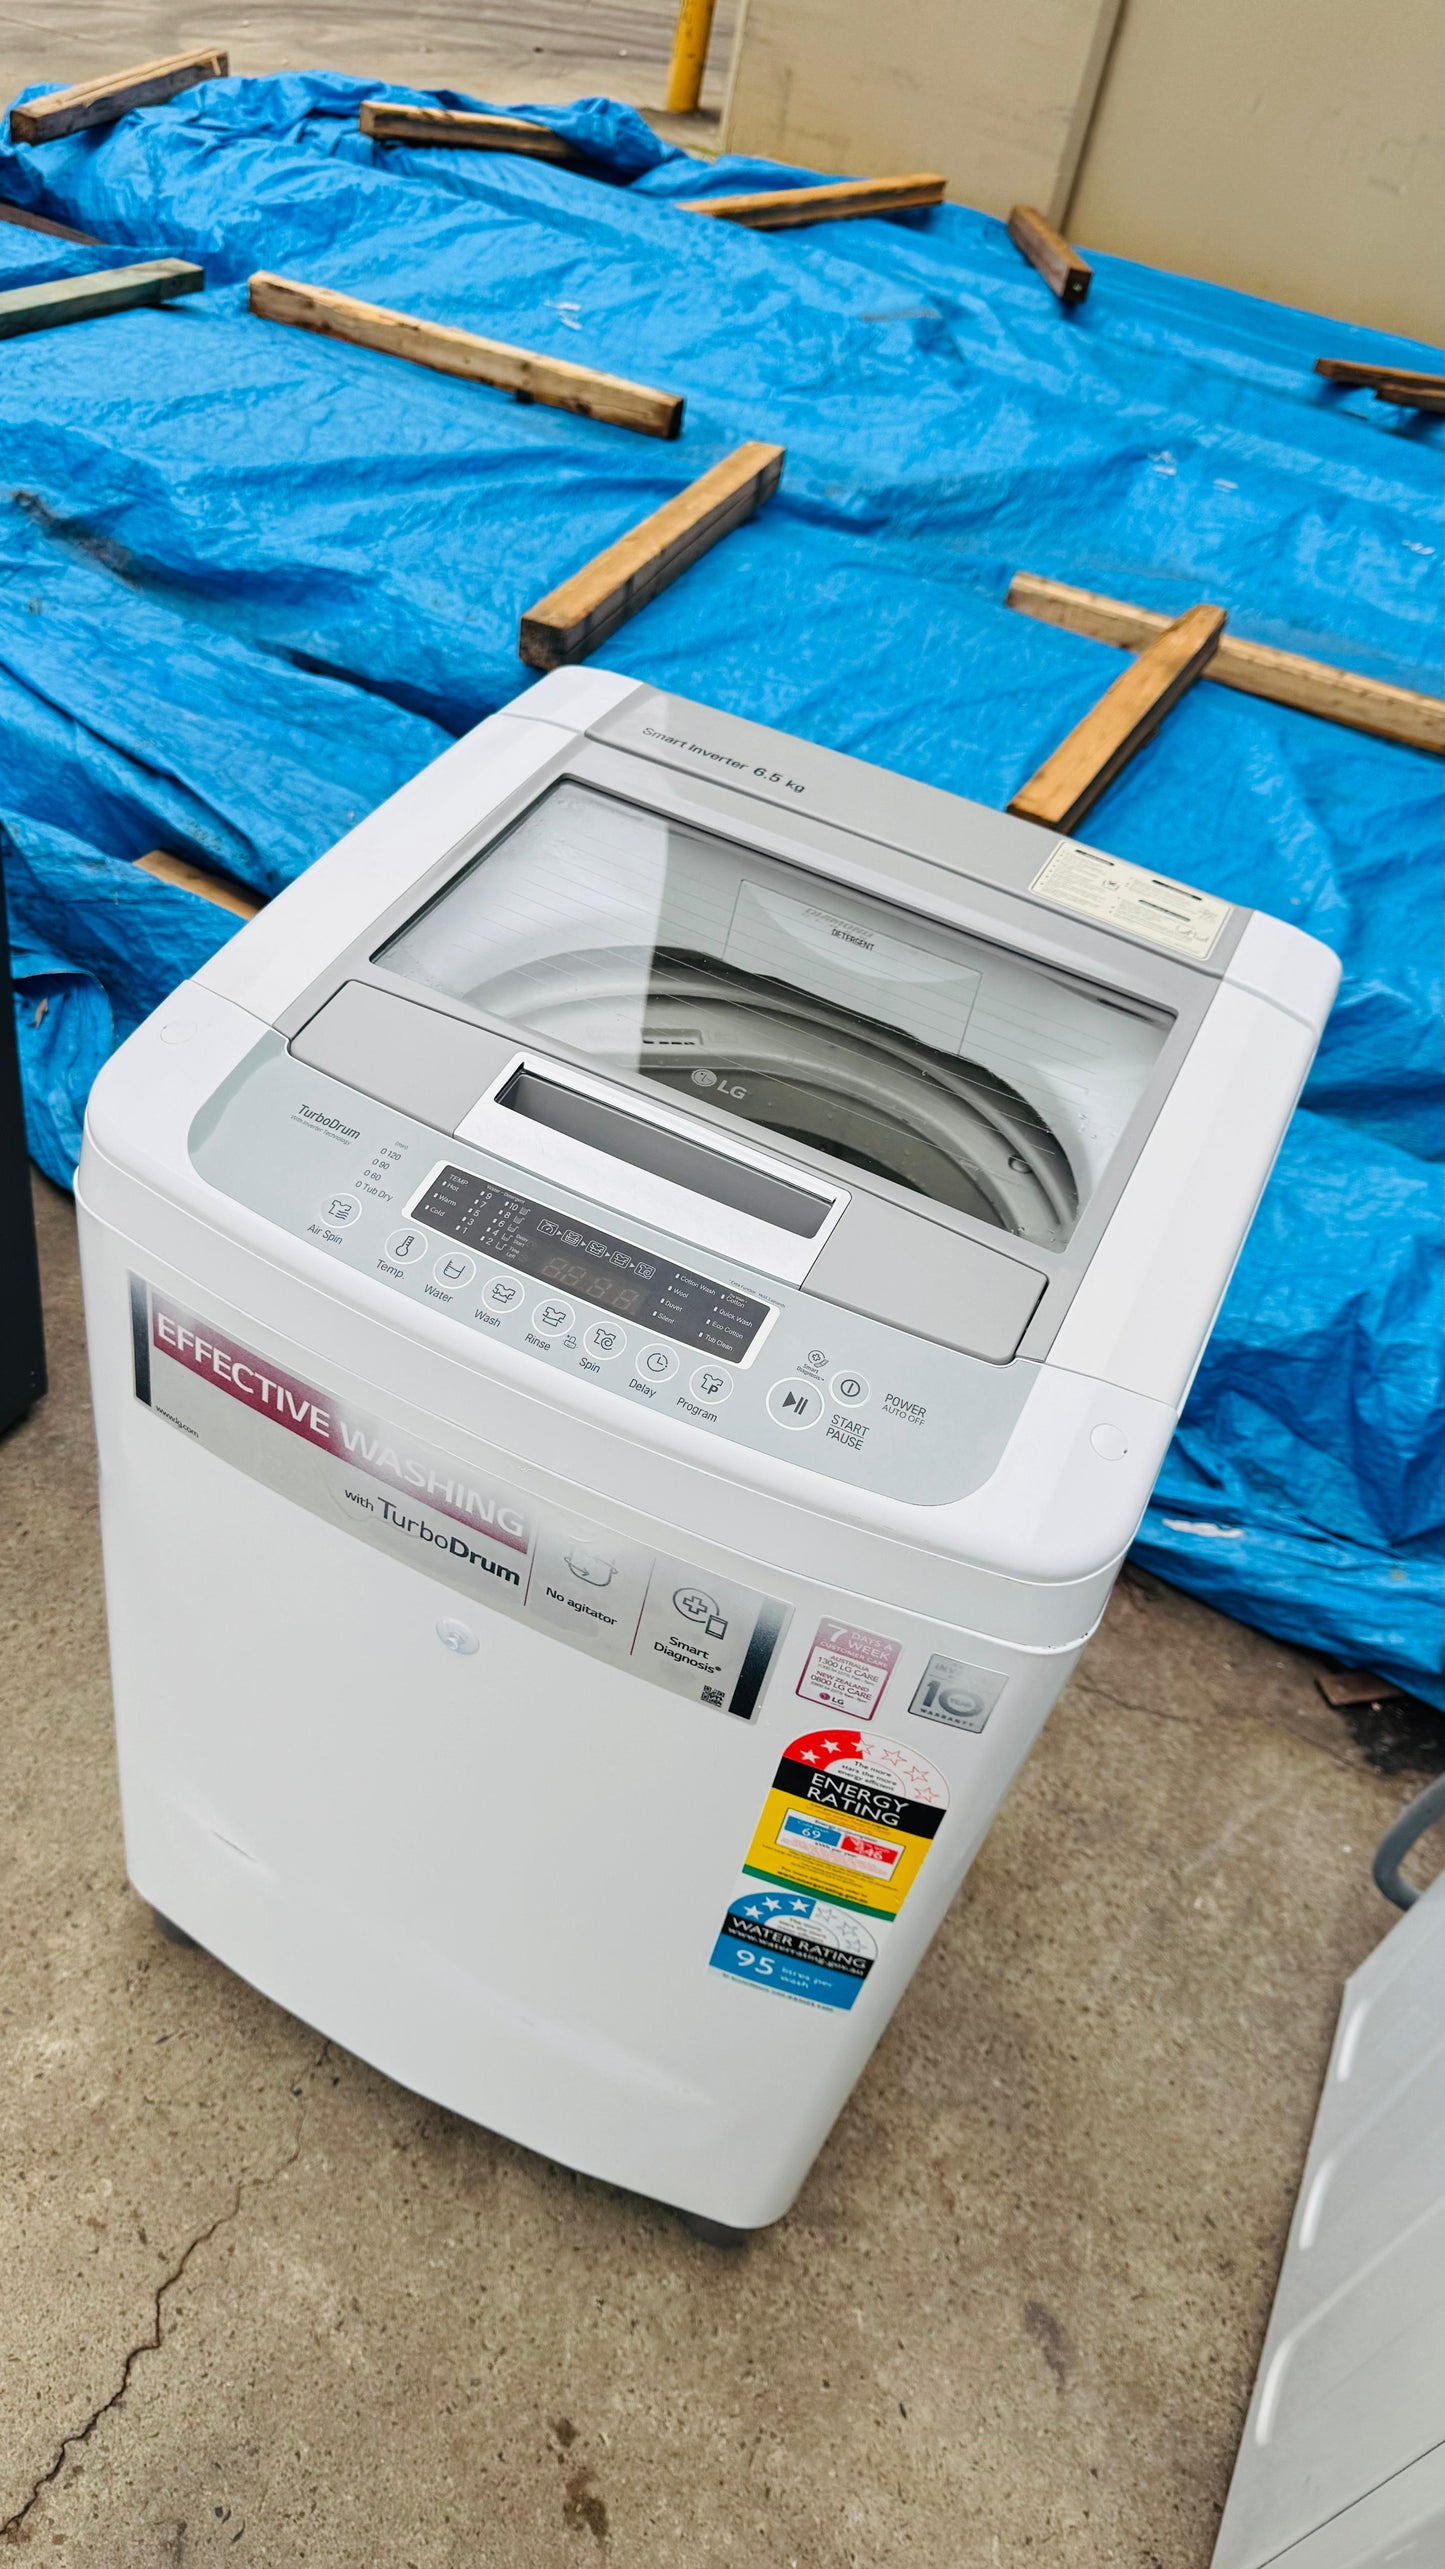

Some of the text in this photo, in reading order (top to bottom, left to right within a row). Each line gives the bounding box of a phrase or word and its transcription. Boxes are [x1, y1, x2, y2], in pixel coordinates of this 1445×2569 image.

[642, 727, 806, 794] Smart Inverter 6.5 kg
[831, 928, 875, 951] DETERGENT
[717, 1080, 748, 1100] LG
[298, 1104, 361, 1139] TurboDrum
[323, 1129, 351, 1145] Technology
[363, 1183, 393, 1202] Tub Dry
[447, 1183, 459, 1192] Hot
[485, 1192, 493, 1200] 9
[439, 1194, 457, 1206] Warm
[479, 1200, 487, 1208] 7
[510, 1202, 519, 1211] 10
[429, 1206, 446, 1217] Cold
[504, 1211, 511, 1219] 8
[467, 1218, 475, 1226] 3
[307, 1224, 343, 1245] Air Spin
[485, 1237, 494, 1245] 2
[376, 1259, 405, 1280] Temp.
[424, 1283, 453, 1303] Water
[673, 1288, 689, 1299] Wool
[680, 1275, 716, 1296] Cotton Wash
[664, 1300, 682, 1312] Duvet
[726, 1296, 745, 1308] Cotton
[474, 1308, 501, 1328] Wash
[657, 1312, 675, 1324] Silent
[719, 1308, 753, 1328] Quick Wash
[712, 1321, 743, 1339] Eco Cotton
[525, 1333, 551, 1351] Rinse
[705, 1333, 733, 1352] Tub Clean
[579, 1357, 601, 1373] Spin
[803, 1363, 819, 1374] Smart
[629, 1378, 657, 1398] Delay
[676, 1397, 718, 1423] Program
[882, 1404, 926, 1426] AUTO OFF
[884, 1393, 927, 1417] POWER
[158, 1312, 524, 1537] EFFECTIVE WASHING
[831, 1414, 870, 1437] START
[826, 1427, 864, 1451] PAUSE
[345, 1489, 520, 1586] with TurboDrum
[546, 1587, 618, 1625] No agitator
[828, 1623, 848, 1643] 7
[851, 1632, 893, 1652] DAYS A
[669, 1636, 710, 1660] Smart
[820, 1641, 889, 1667] CUSTOMER CARE
[847, 1640, 890, 1661] WEEK
[818, 1656, 839, 1668] 1300
[840, 1665, 852, 1673] LG
[854, 1670, 879, 1683] CARE
[830, 1655, 870, 1672] AUSTRALIA
[810, 1674, 832, 1686] 0800
[833, 1682, 845, 1691] LG
[847, 1688, 872, 1700] CARE
[815, 1670, 834, 1680] NEW
[834, 1677, 869, 1692] ZEALAND
[831, 1697, 844, 1705] LG
[923, 1680, 984, 1717] 10
[920, 1708, 974, 1727] WARRANTY
[841, 1764, 860, 1773] stars
[876, 1776, 897, 1786] more
[854, 1760, 892, 1777] The more
[838, 1769, 895, 1791] energy efficient
[811, 1773, 910, 1813] ENERGY
[807, 1786, 901, 1827] RATING
[801, 1828, 822, 1839] 69
[728, 1927, 865, 1977] www.waterrating.gov.au
[733, 1917, 793, 1946] WATER
[798, 1940, 867, 1969] RATING
[736, 1949, 776, 1976] 95
